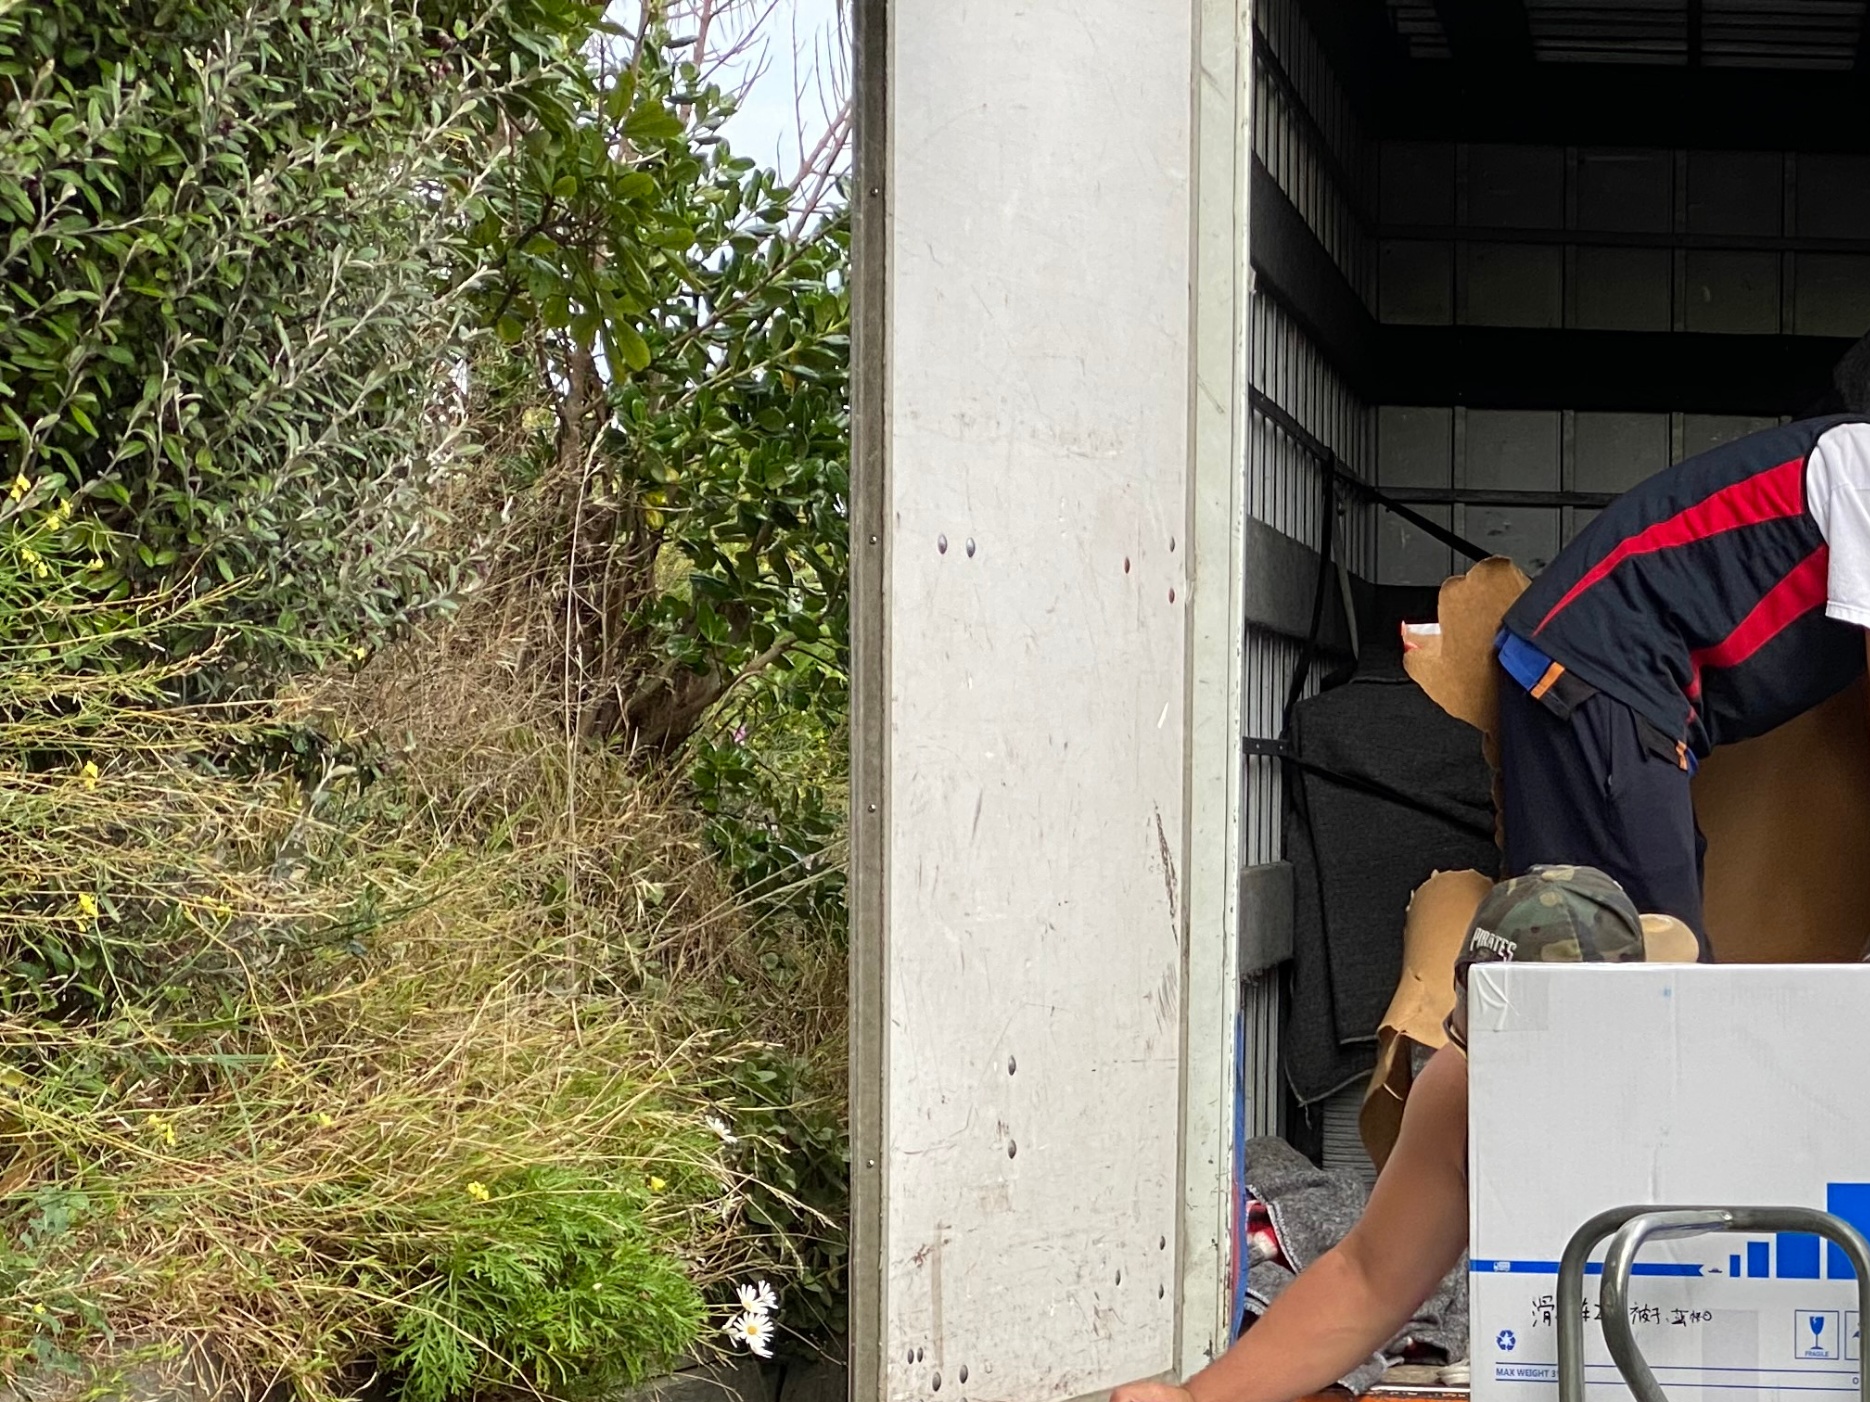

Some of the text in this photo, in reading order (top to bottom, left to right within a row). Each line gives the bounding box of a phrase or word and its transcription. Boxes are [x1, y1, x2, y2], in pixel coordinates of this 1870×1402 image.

[1469, 927, 1518, 962] PIRATES
[1496, 1367, 1515, 1377] MAX
[1517, 1368, 1549, 1377] WEIGHT
